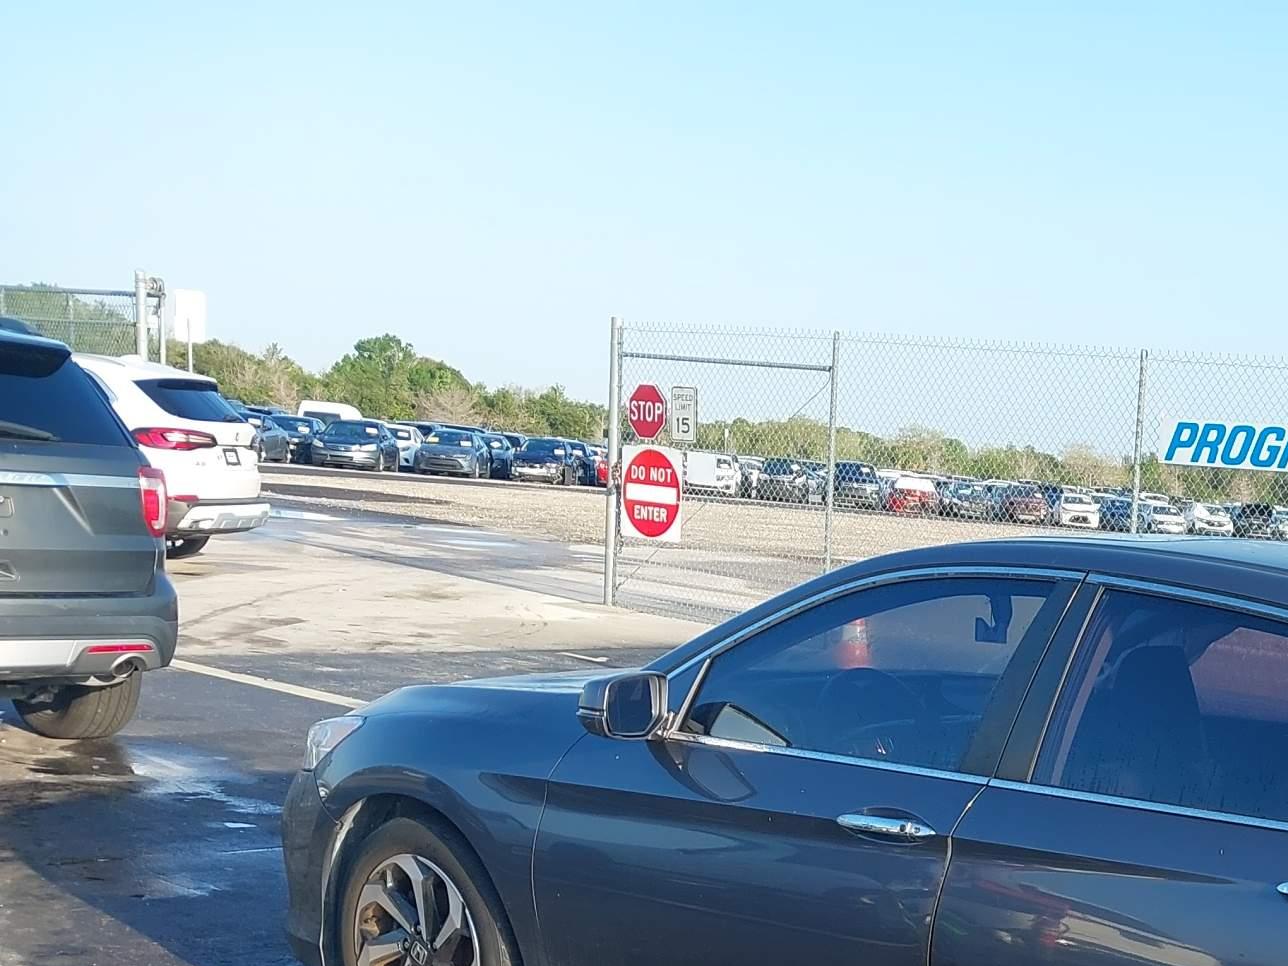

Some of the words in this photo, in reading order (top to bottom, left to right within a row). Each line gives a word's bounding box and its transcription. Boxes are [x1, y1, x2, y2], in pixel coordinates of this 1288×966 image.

[673, 393, 693, 402] SPEED
[631, 400, 662, 422] STOP
[674, 403, 692, 411] LIMIT
[676, 417, 690, 434] 15
[631, 465, 646, 480] DO
[650, 466, 673, 483] NOT
[633, 505, 668, 523] ENTER
